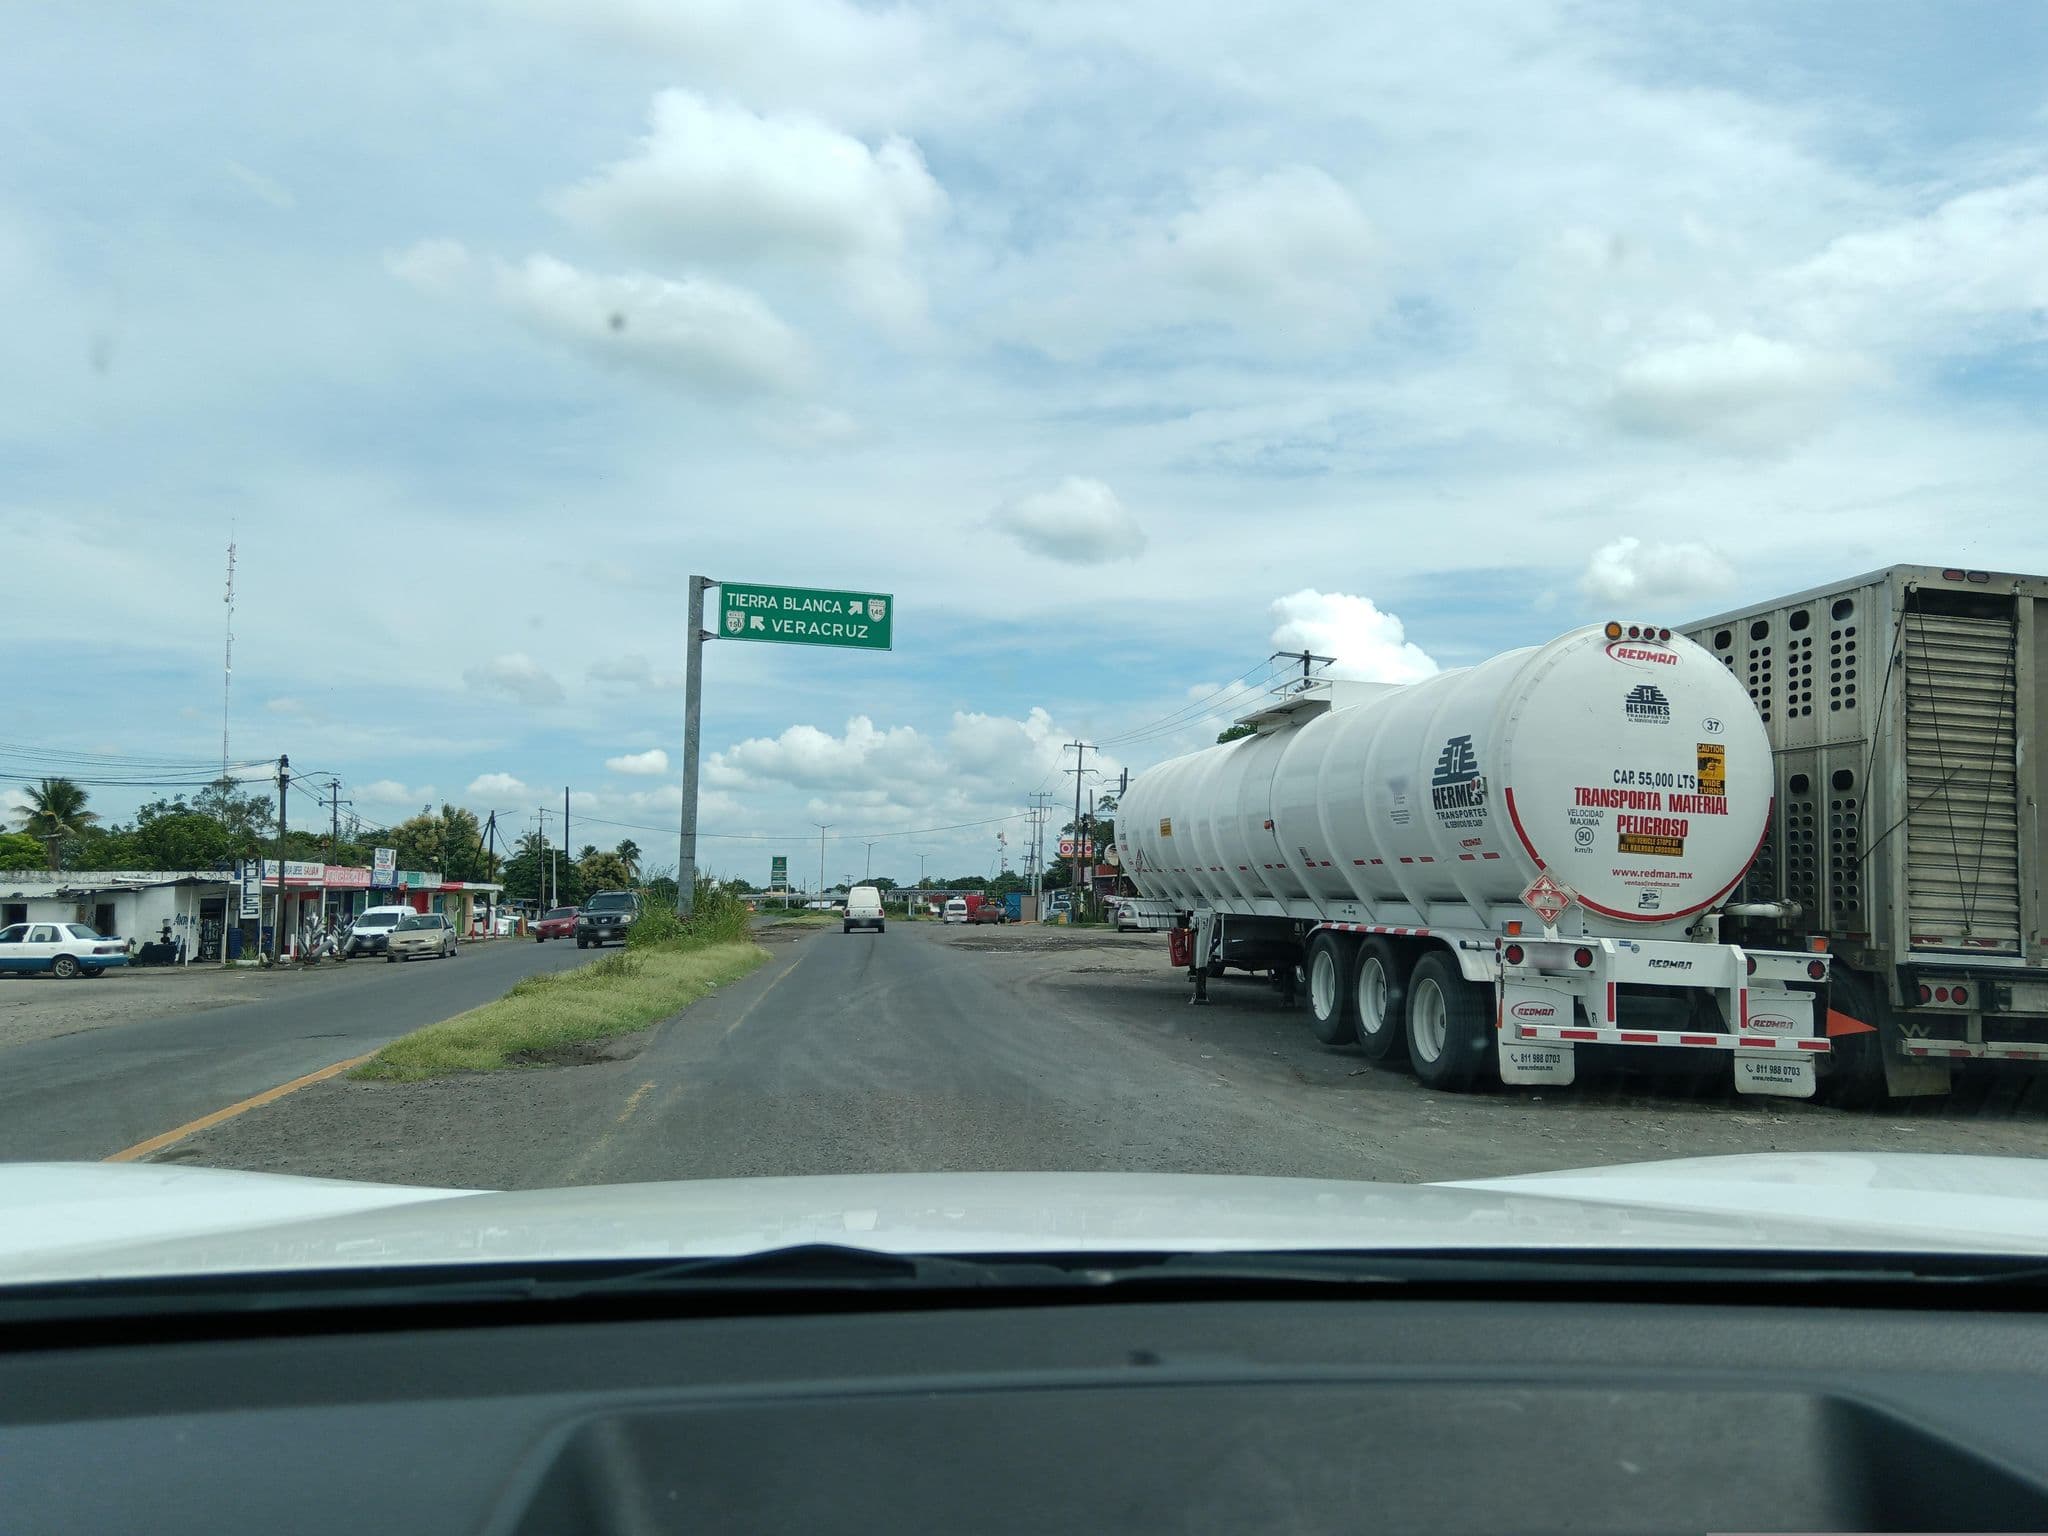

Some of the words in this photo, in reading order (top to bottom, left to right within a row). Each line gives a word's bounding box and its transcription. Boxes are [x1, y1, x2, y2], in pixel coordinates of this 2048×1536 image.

[727, 592, 778, 610] TIERRA
[783, 597, 843, 614] BLANCA
[771, 618, 869, 639] VERACRUZ
[1616, 646, 1679, 666] REDMAN
[1625, 703, 1670, 716] HERMES
[1706, 720, 1720, 732] 37
[1697, 743, 1725, 754] CAUTION
[1638, 771, 1674, 789] 55,000
[1677, 774, 1696, 789] LTS
[1702, 779, 1721, 788] WIDE
[1699, 787, 1724, 795] TURNS
[1432, 783, 1484, 811] HERMES
[1574, 787, 1661, 811] TRANSPORTA
[1669, 793, 1729, 815] MATERIAL
[1436, 808, 1488, 821] TRANSPORTES
[1567, 808, 1604, 818] VELOCIDAD
[1617, 814, 1688, 838] PELIGROSO
[1578, 831, 1591, 841] 90
[1574, 846, 1593, 854] km/h
[1612, 868, 1693, 879] www.redman.mx
[1545, 909, 1552, 917] 3
[1648, 959, 1693, 970] REDMAN
[1518, 1008, 1555, 1016] REDMAN
[1753, 1019, 1794, 1030] REDMAN
[1520, 1053, 1531, 1063] 811
[1533, 1053, 1544, 1063] 988
[1545, 1053, 1561, 1064] 0703
[1756, 1064, 1768, 1074] 811
[1769, 1065, 1782, 1075] 988
[1783, 1066, 1801, 1076] 0703
